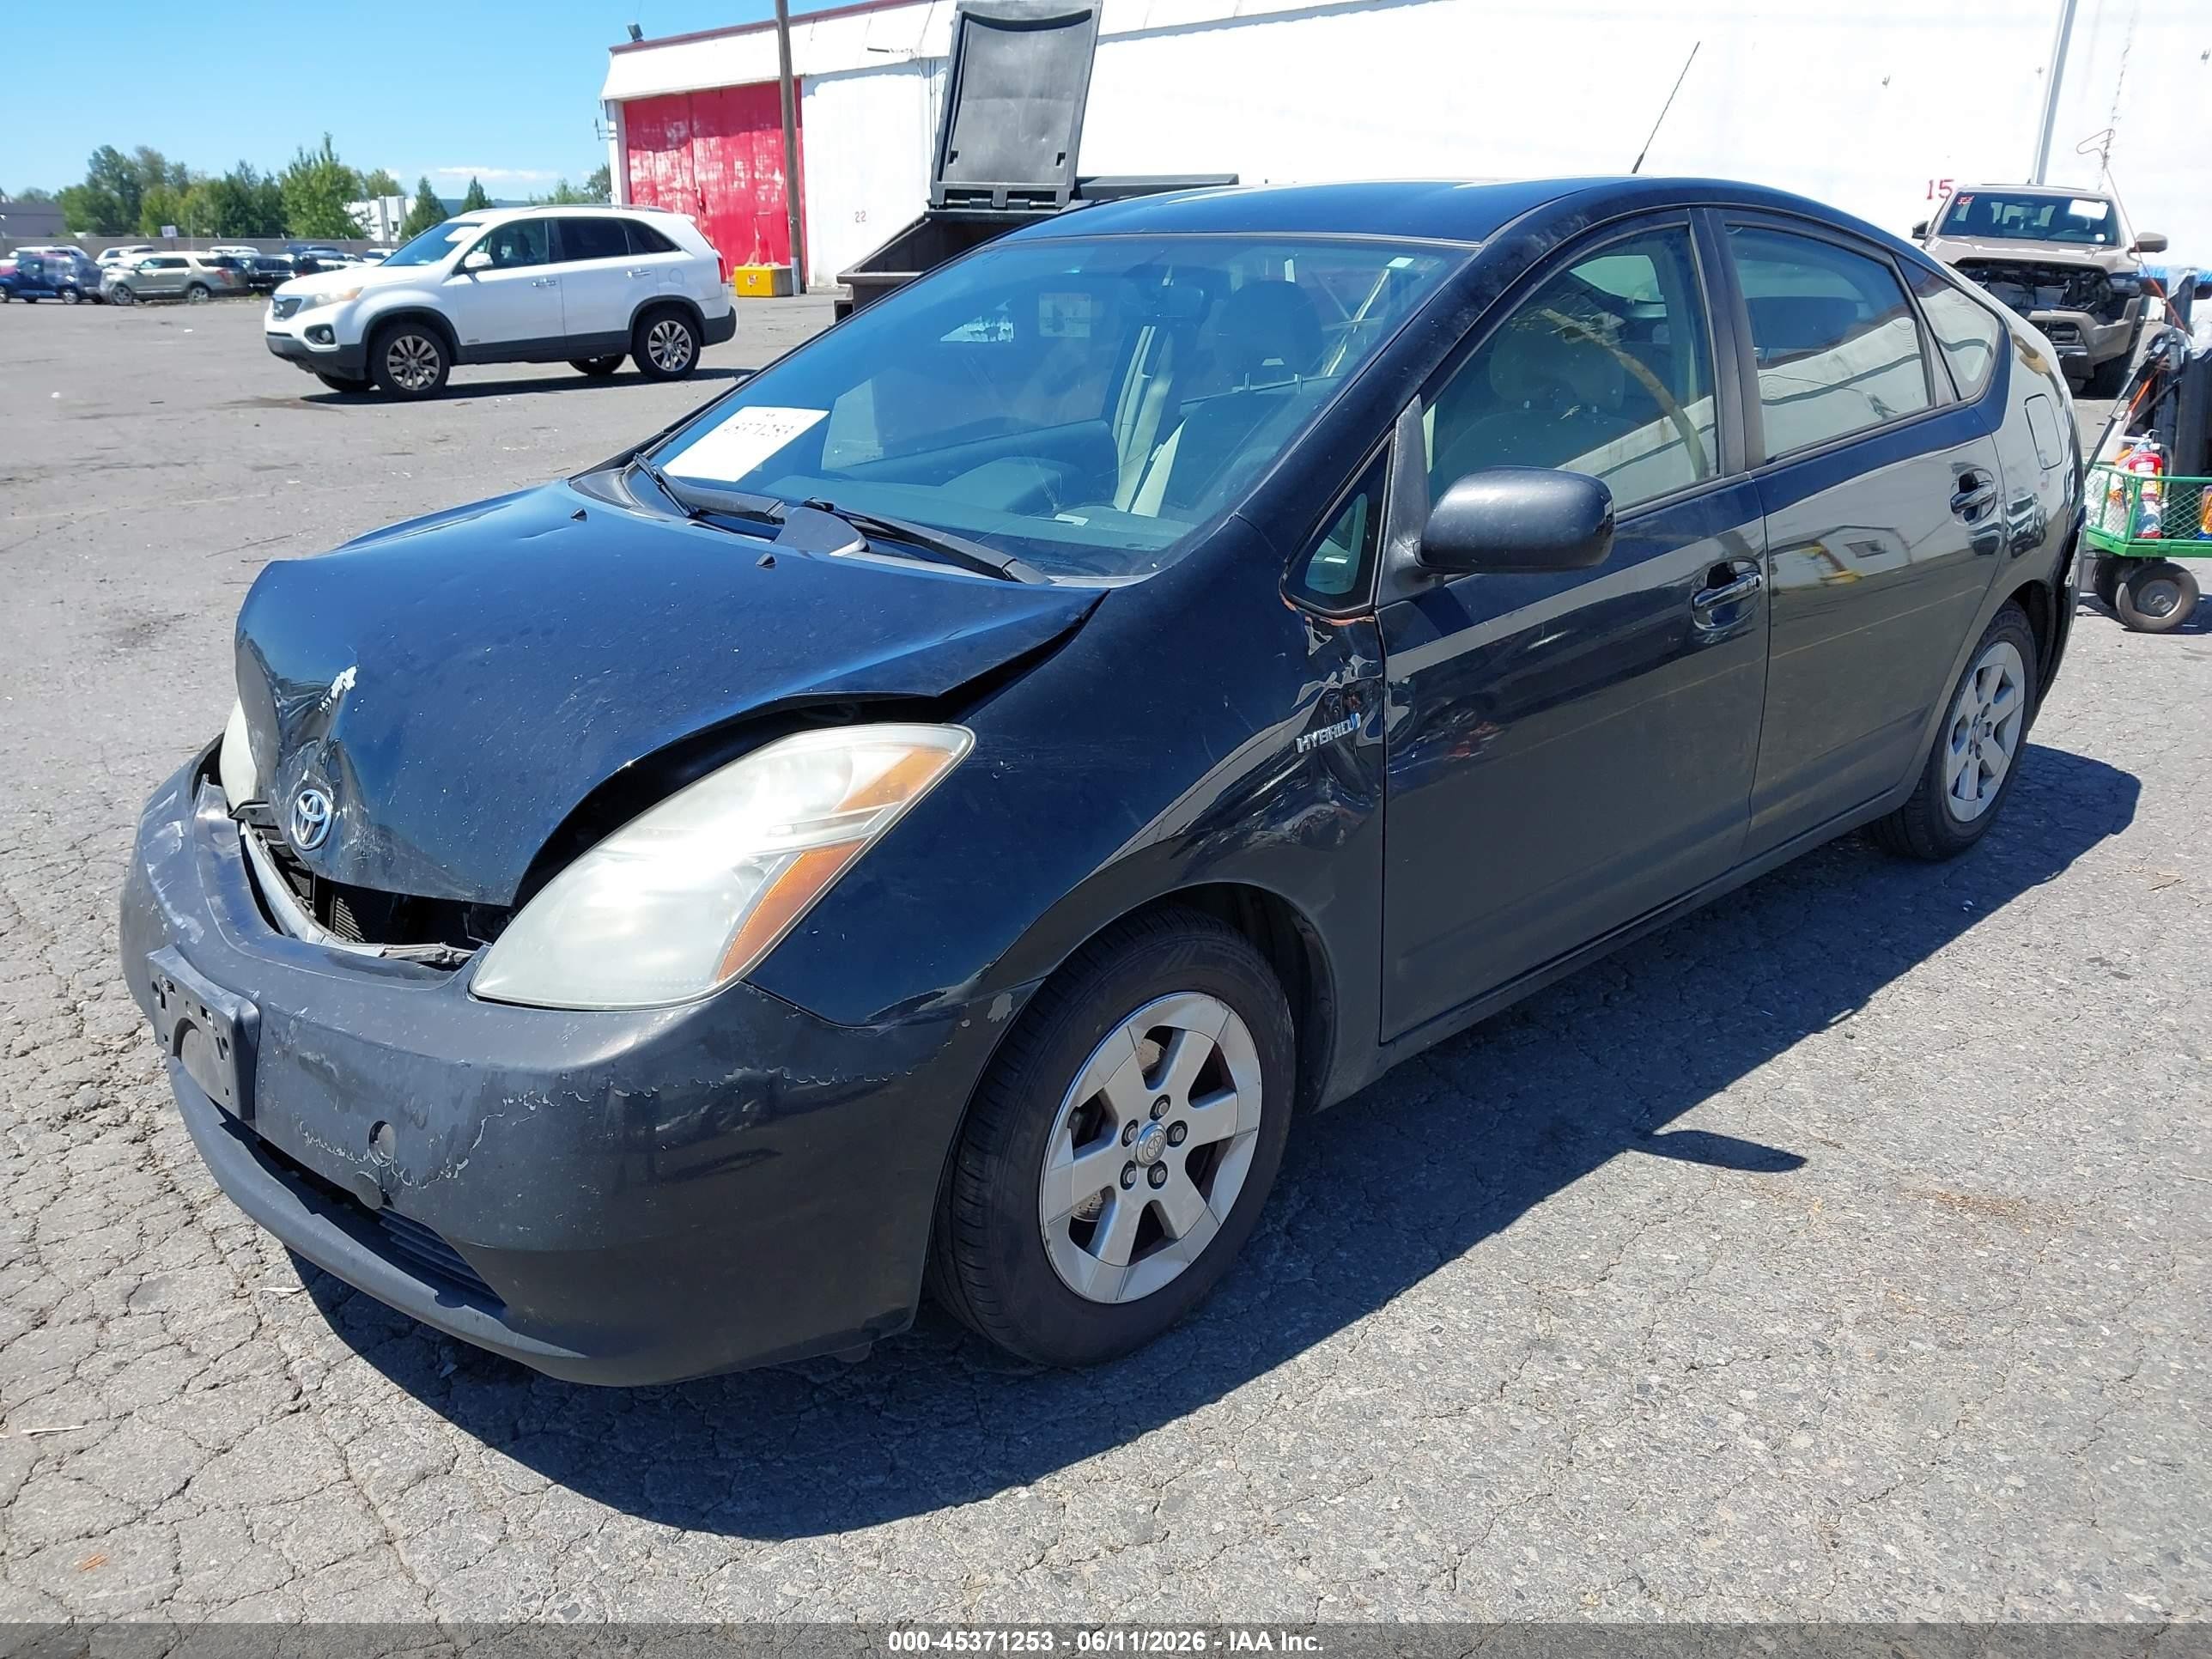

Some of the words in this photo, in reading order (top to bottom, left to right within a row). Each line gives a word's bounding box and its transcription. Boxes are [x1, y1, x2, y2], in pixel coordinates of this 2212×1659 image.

[1926, 178, 1954, 201] 15
[854, 210, 867, 223] 22
[1295, 712, 1361, 754] HYBRID
